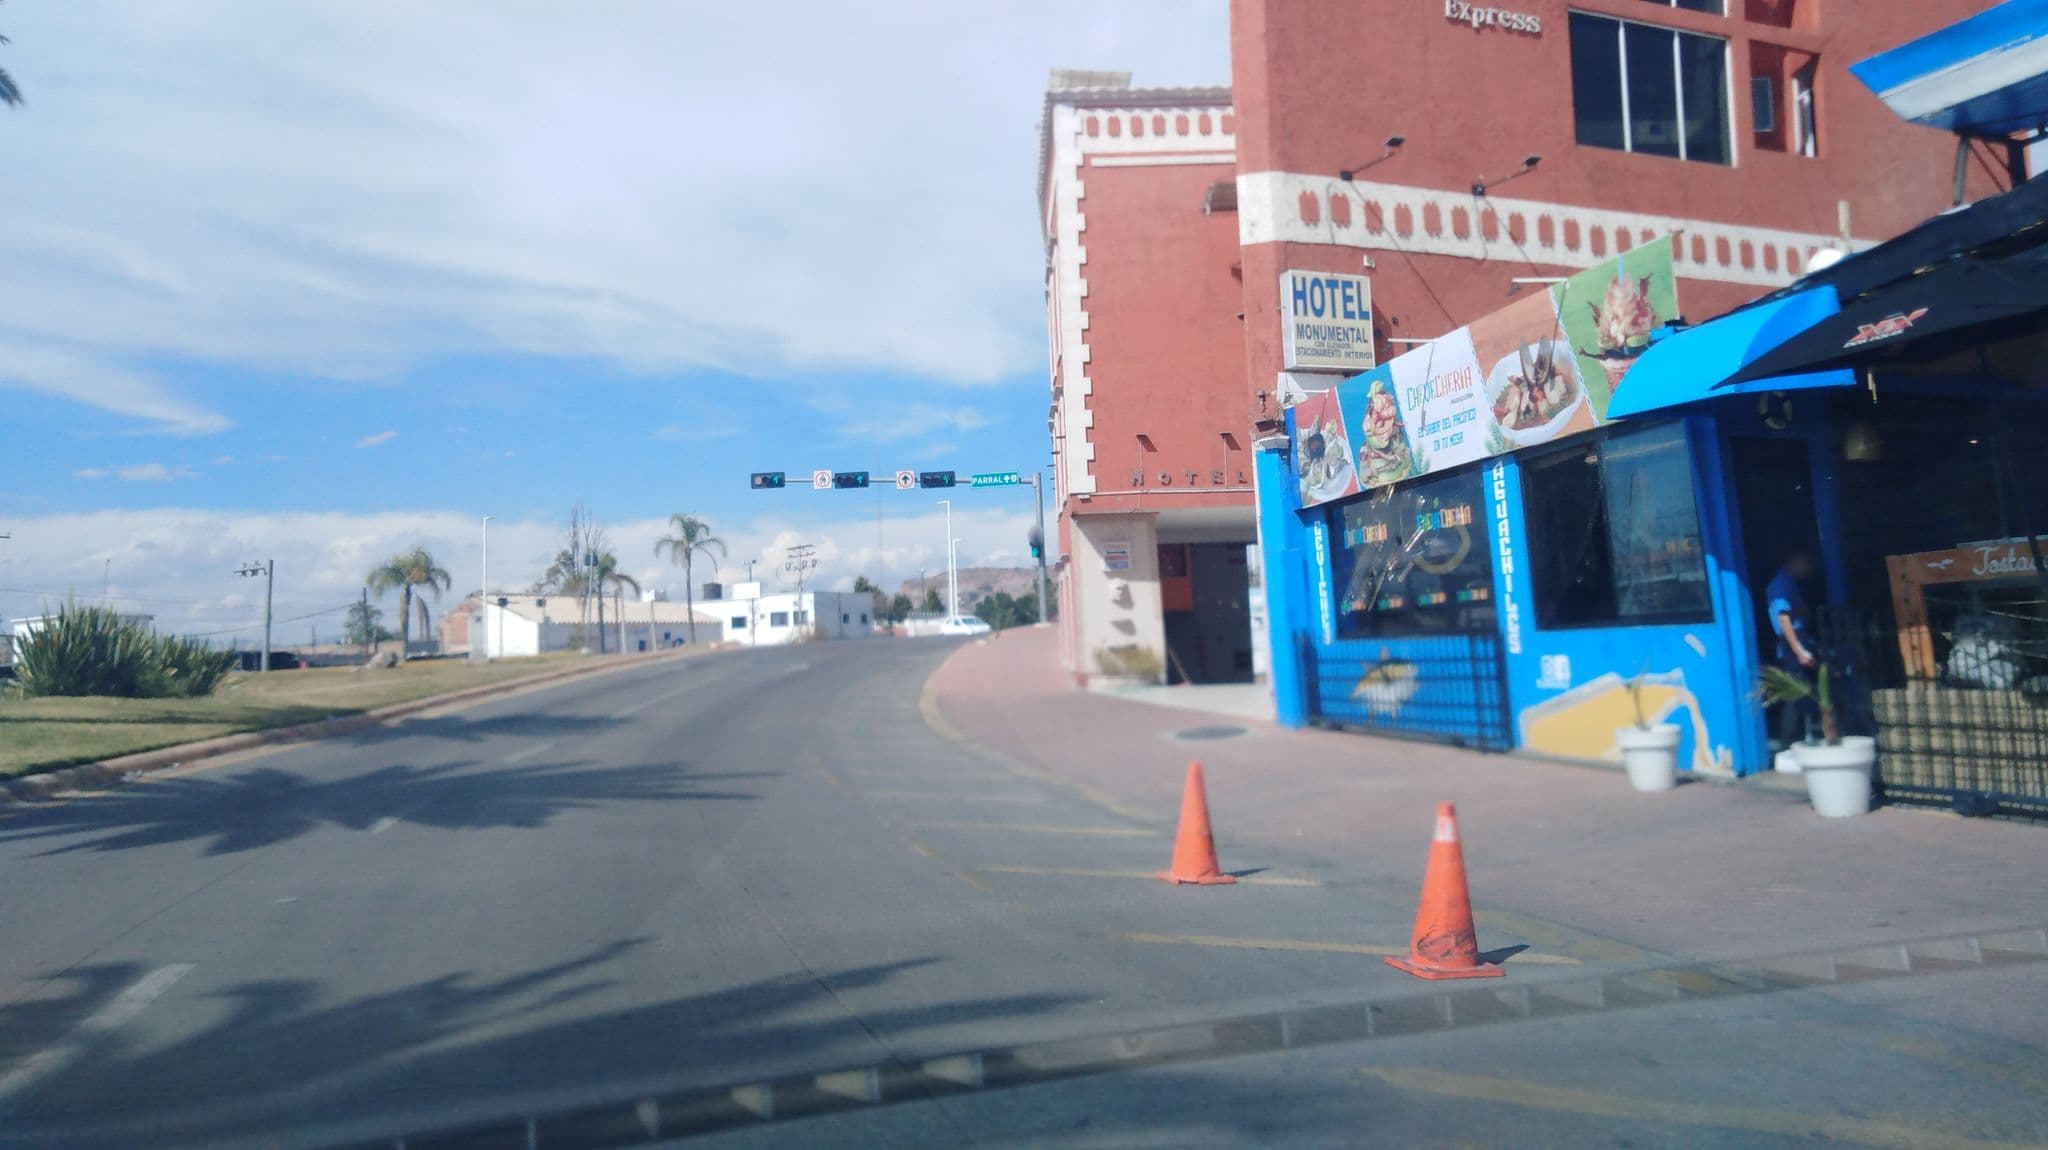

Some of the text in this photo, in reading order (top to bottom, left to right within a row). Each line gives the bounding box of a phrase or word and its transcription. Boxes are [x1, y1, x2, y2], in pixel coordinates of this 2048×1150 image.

[1445, 0, 1541, 33] Express
[1292, 275, 1370, 320] HOTEL
[1296, 323, 1369, 343] MONUMENTAL
[972, 476, 1003, 485] PARRAL
[1129, 471, 1247, 487] HOTEL
[1493, 461, 1521, 654] AGUACHILES
